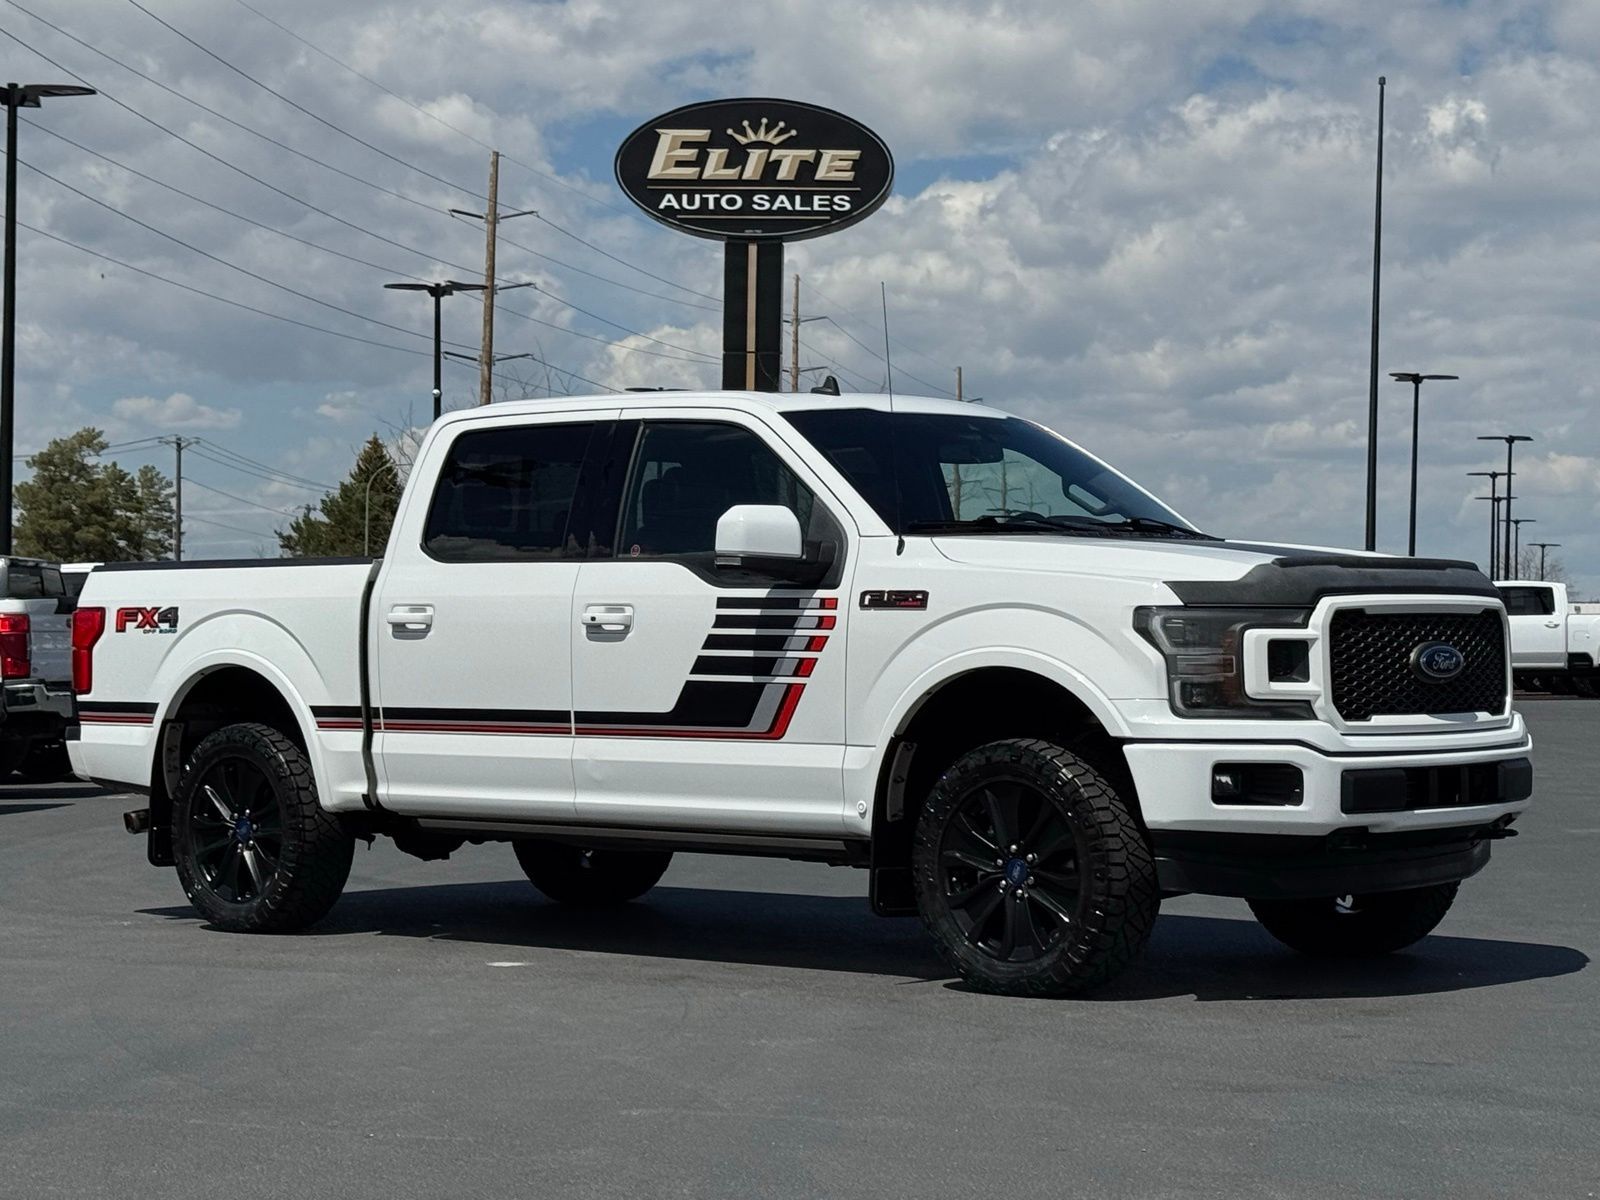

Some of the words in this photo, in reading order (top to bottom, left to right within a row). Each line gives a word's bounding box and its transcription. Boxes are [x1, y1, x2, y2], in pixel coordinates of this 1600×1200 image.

[646, 128, 862, 182] ELITE
[658, 193, 743, 211] AUTO
[752, 194, 851, 212] SALES
[115, 606, 179, 633] FX4
[1432, 652, 1457, 670] Ford
